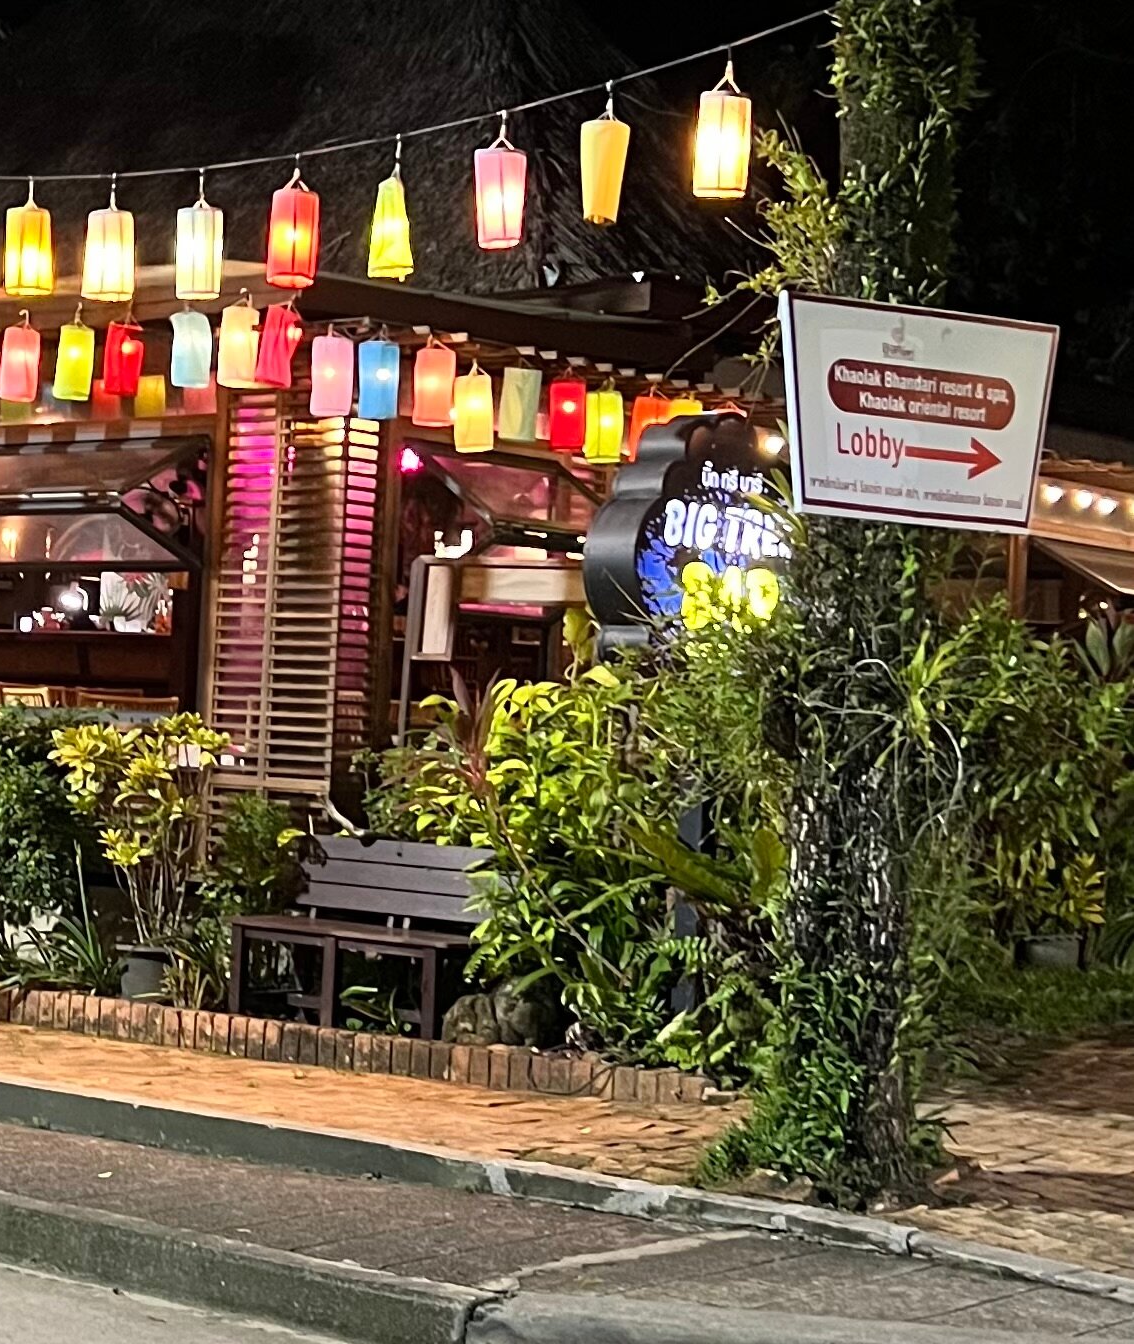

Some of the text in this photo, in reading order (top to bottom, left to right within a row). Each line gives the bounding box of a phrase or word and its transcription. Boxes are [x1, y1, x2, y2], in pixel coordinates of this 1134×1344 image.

[834, 365, 882, 385] Khaolak
[884, 371, 937, 393] Bhandari
[939, 380, 972, 398] resort
[975, 383, 984, 398] &
[859, 391, 986, 422] Khaolak oriental resort
[836, 422, 904, 468] Lobby
[664, 498, 717, 550] BIG
